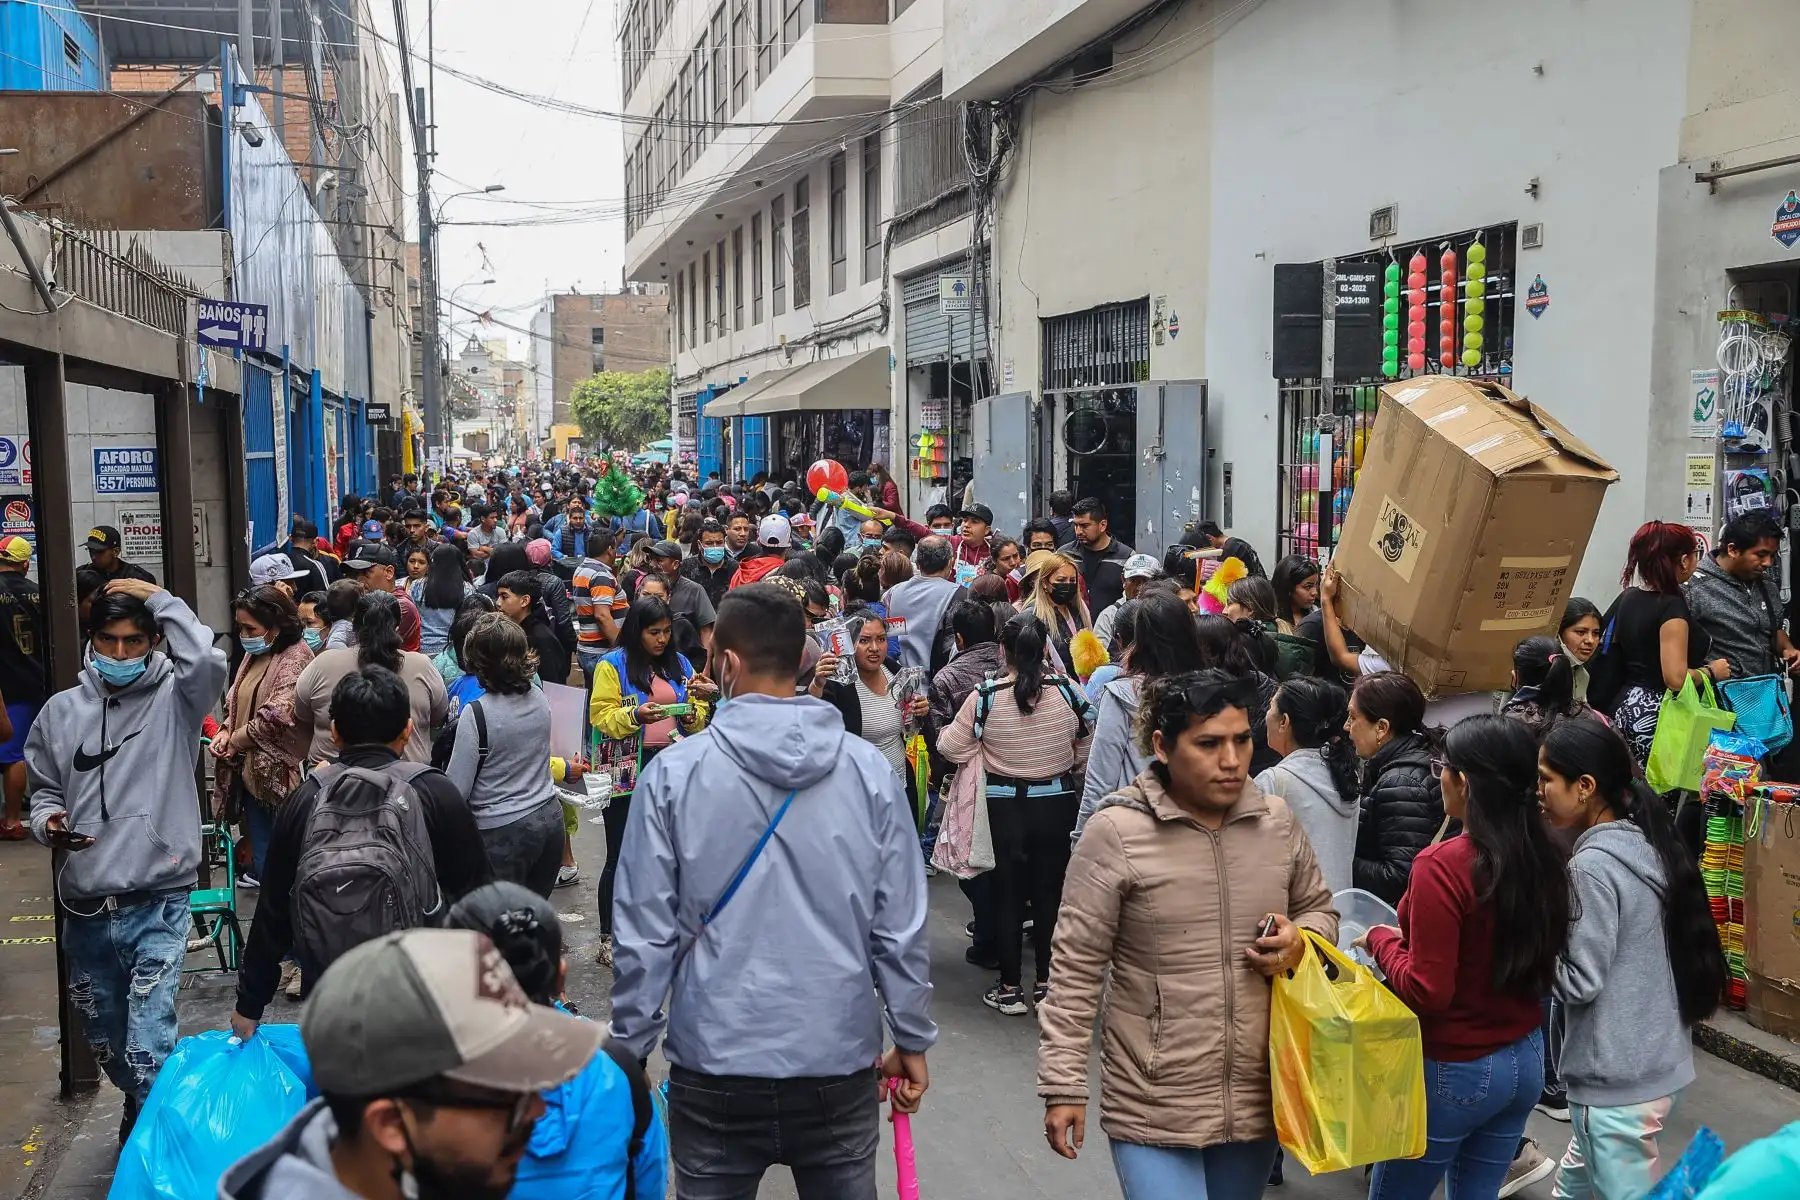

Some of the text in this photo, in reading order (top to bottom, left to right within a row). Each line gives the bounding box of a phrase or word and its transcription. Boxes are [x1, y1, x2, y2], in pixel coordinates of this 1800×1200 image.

[199, 302, 241, 324] BAÑOS
[98, 450, 154, 465] AFORO
[100, 465, 131, 473] CAPACIDAD
[99, 476, 157, 490] 557 PERSONAS
[2, 520, 35, 528] CELEBRA
[1496, 581, 1510, 589] KGS
[1493, 591, 1507, 599] KGS
[621, 697, 636, 707] PRA
